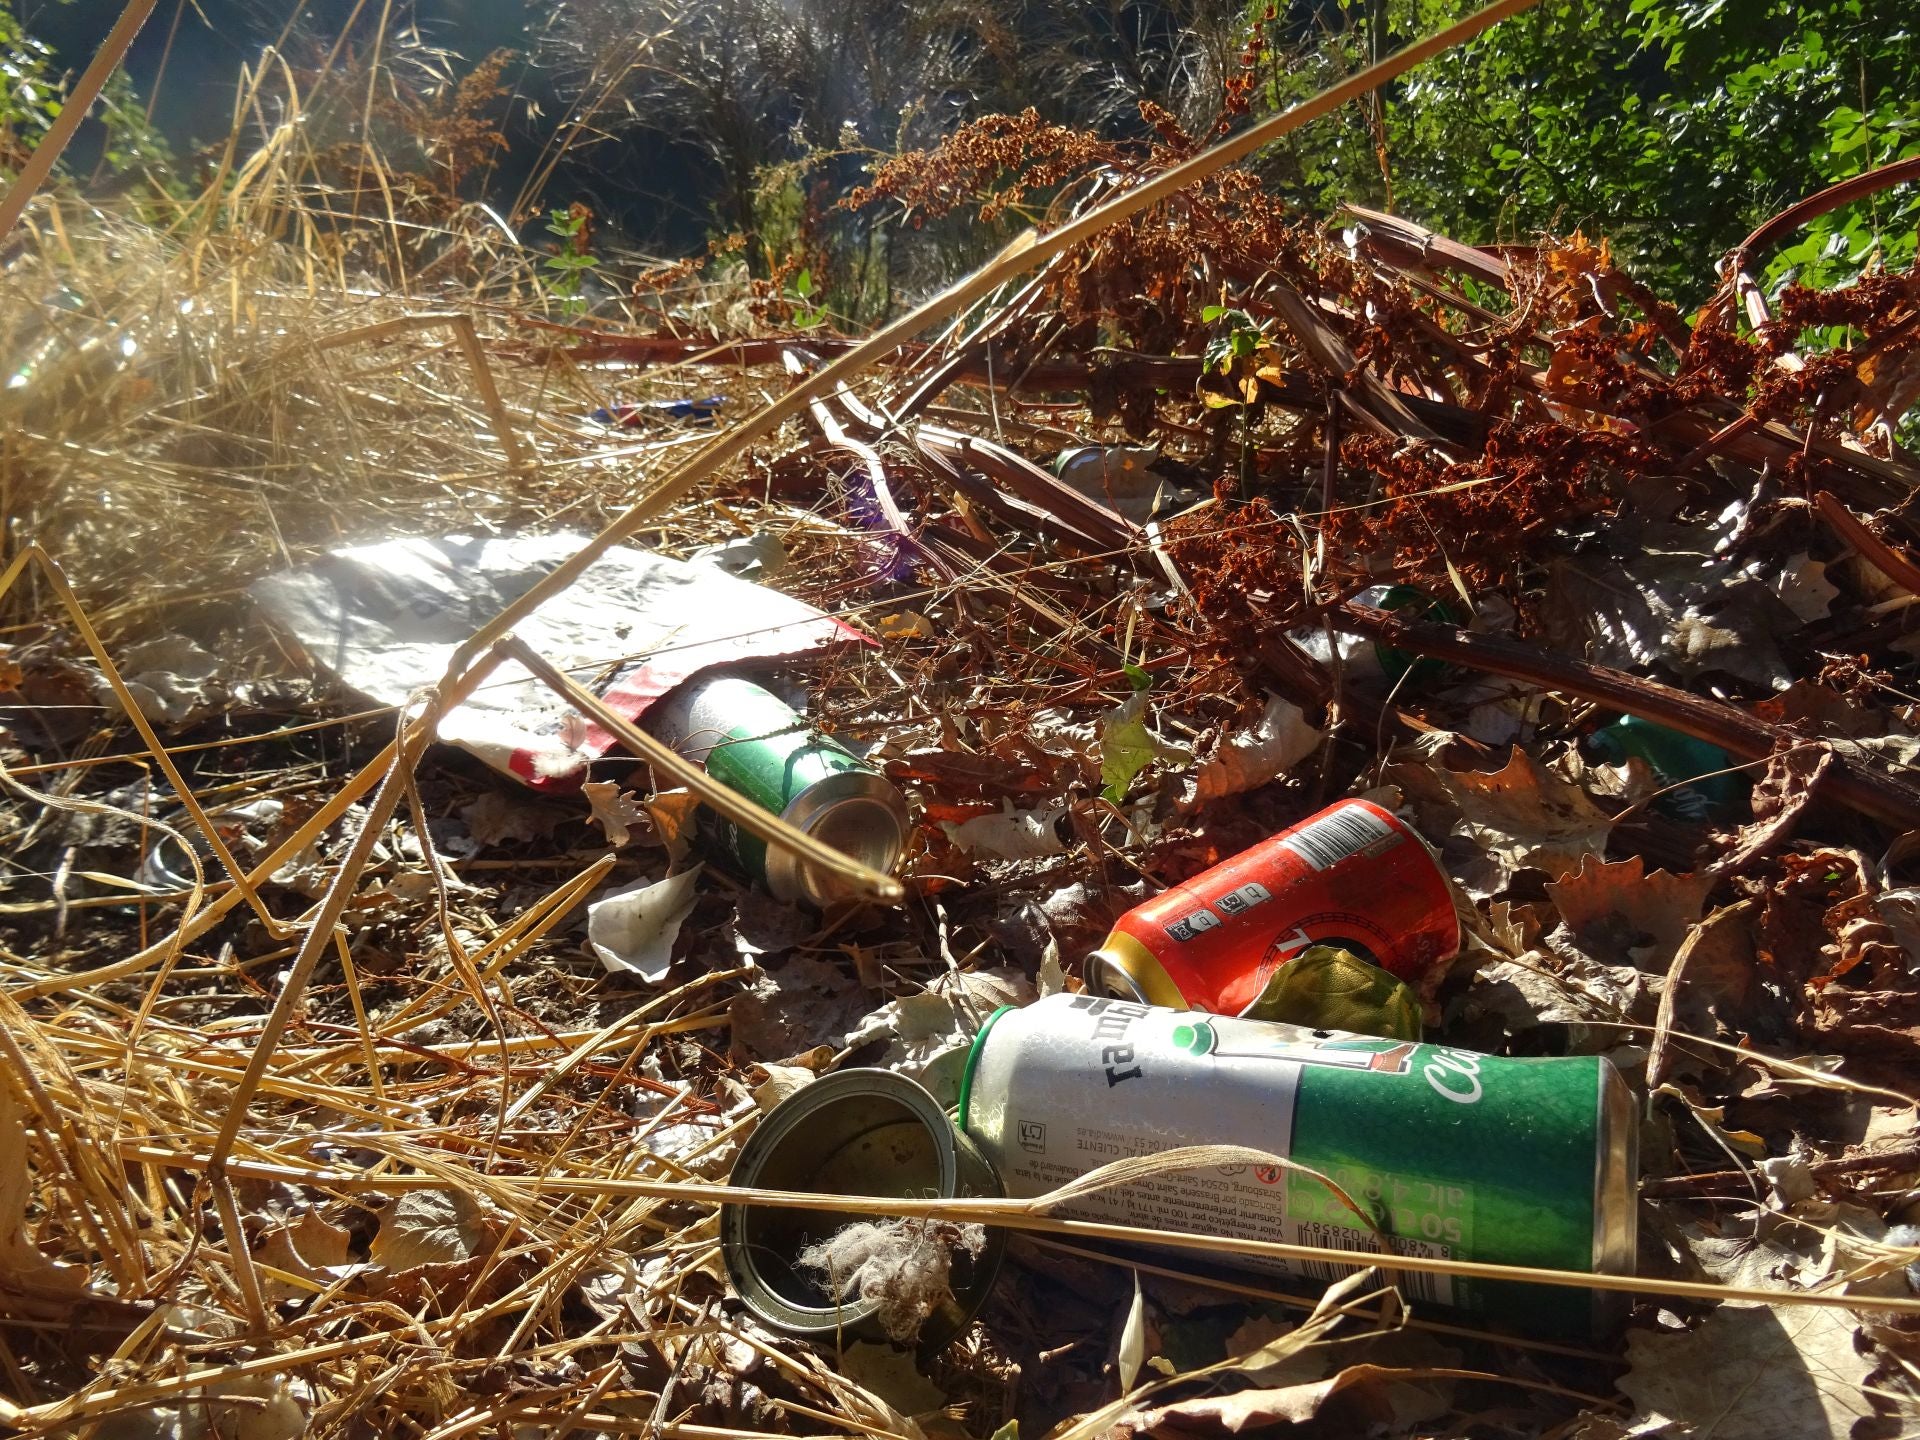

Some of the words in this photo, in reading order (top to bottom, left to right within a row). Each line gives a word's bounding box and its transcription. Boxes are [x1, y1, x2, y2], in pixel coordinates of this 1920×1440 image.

[1076, 1138, 1120, 1156] CLIENTE
[1157, 1183, 1178, 1196] Saint
[1201, 1179, 1229, 1192] 62504
[1136, 1191, 1160, 1203] antes
[1222, 1195, 1236, 1204] por
[1162, 1196, 1237, 1216] preferentemente
[1239, 1198, 1282, 1215] Fabricado
[1171, 1208, 1188, 1220] 100
[1191, 1212, 1206, 1220] por
[1238, 1210, 1282, 1226] Consumir
[1164, 1218, 1188, 1228] antes
[1191, 1223, 1218, 1234] agitar
[1208, 1215, 1256, 1232] energético
[1421, 1212, 1462, 1242] 50
[1220, 1228, 1233, 1238] No
[1259, 1226, 1283, 1238] Valor
[1302, 1220, 1360, 1240] 028587
[1367, 1233, 1428, 1252] 48007
[1440, 1245, 1449, 1258] 8
